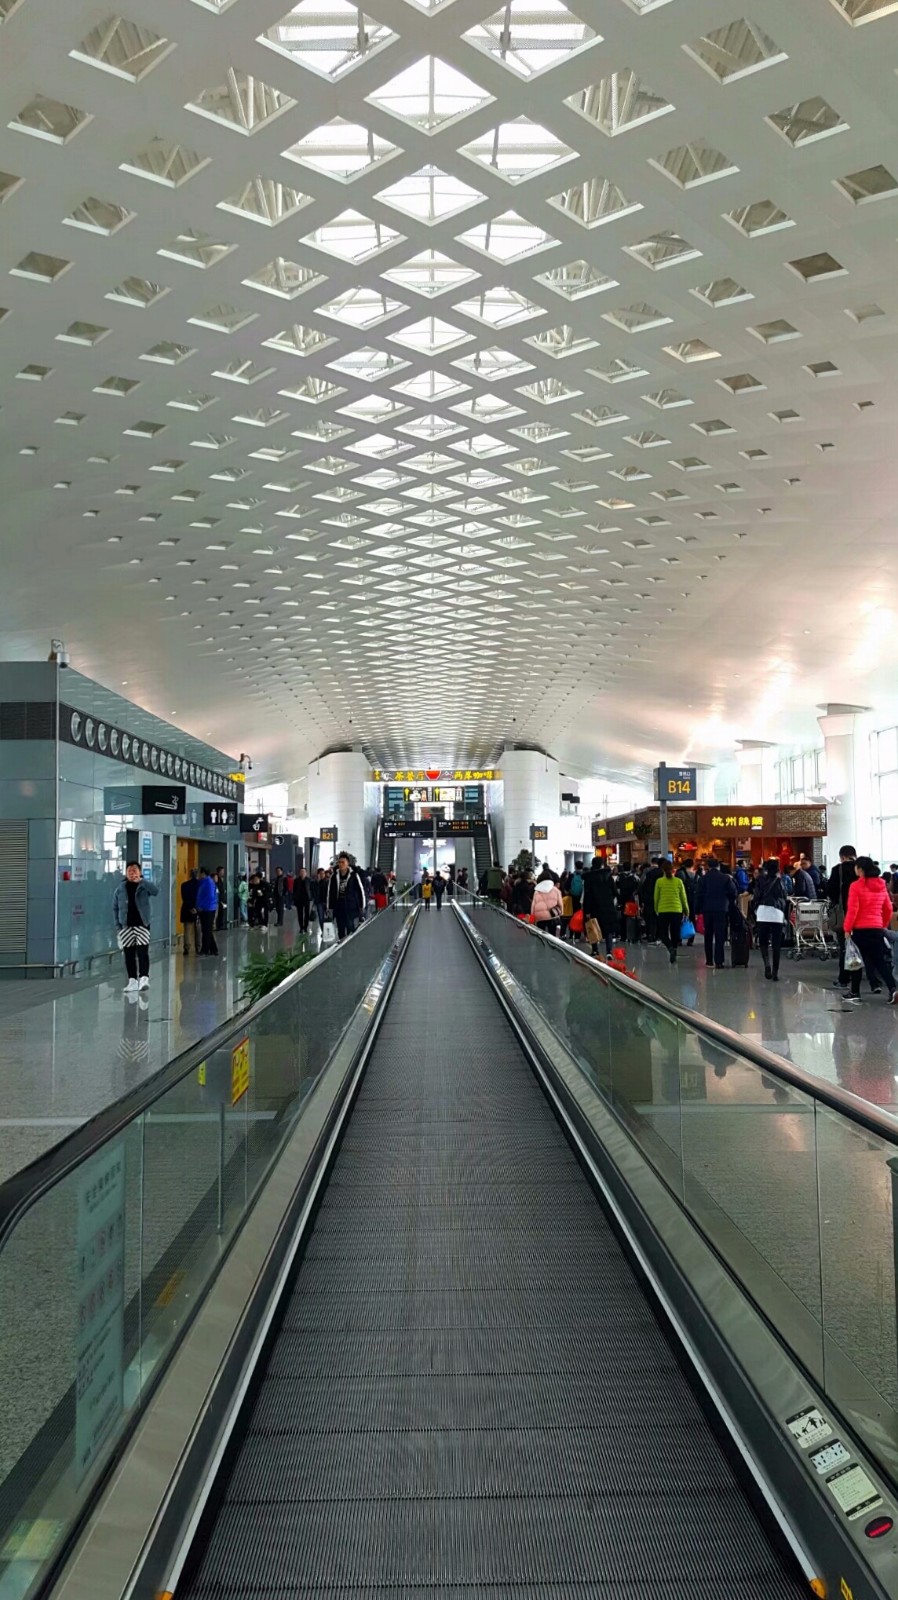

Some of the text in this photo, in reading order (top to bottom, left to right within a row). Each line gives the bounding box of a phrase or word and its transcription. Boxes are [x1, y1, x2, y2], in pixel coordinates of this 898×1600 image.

[395, 771, 424, 780] 茶餐厅
[454, 771, 494, 780] 两岸咖啡
[668, 780, 690, 794] B14
